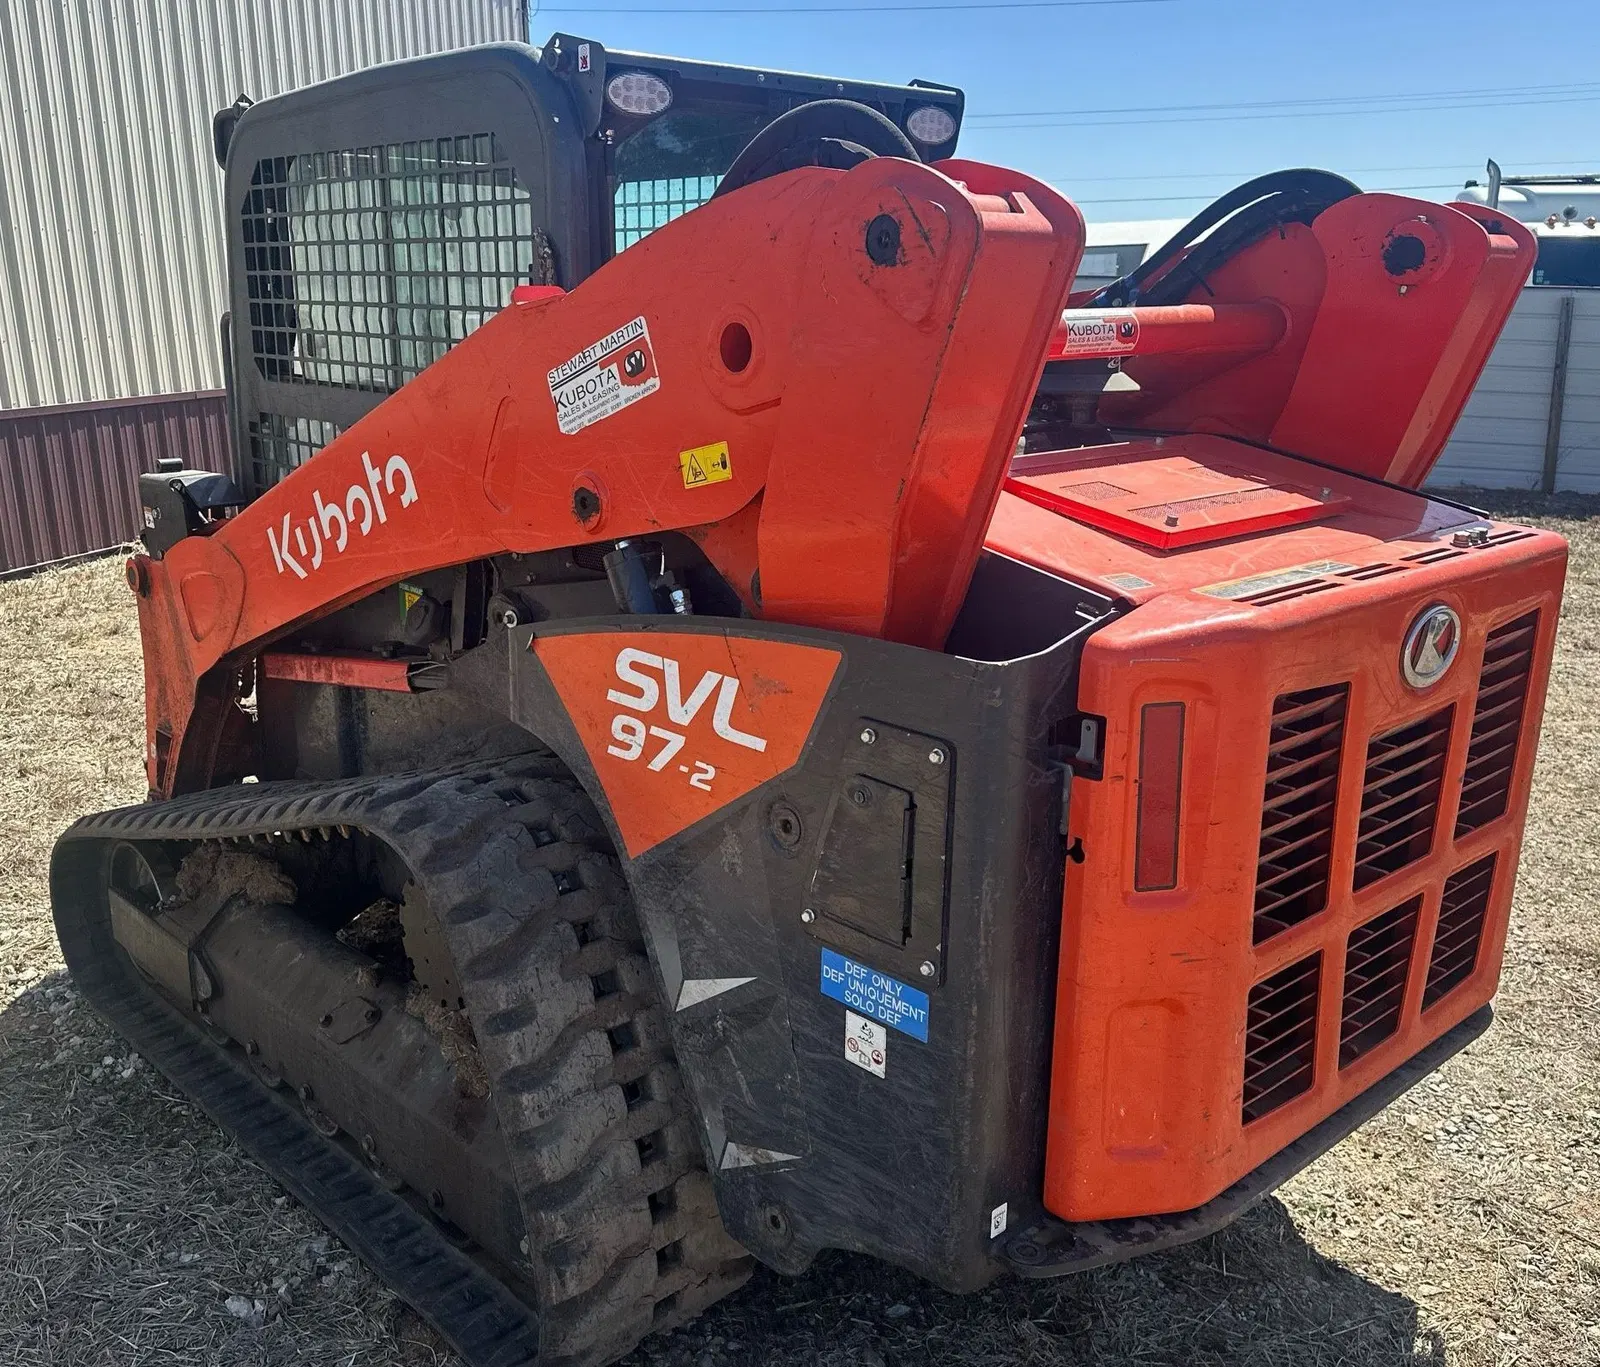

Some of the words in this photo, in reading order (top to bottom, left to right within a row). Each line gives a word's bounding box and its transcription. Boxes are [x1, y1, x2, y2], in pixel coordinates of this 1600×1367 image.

[548, 345, 597, 383] STEWART
[600, 318, 644, 353] MARTIN
[1067, 323, 1115, 336] KUBOTA
[553, 368, 617, 412] KUBOTA
[558, 405, 581, 421] SALES
[582, 401, 588, 409] &
[588, 382, 621, 405] LEASING
[267, 451, 419, 580] Kubota
[606, 647, 767, 752] SVL
[606, 714, 716, 791] 97-2
[823, 965, 845, 984] DEF
[848, 976, 926, 1023] UNIQUEMENT
[845, 960, 868, 979] DEF
[871, 974, 903, 997] ONLY
[844, 990, 874, 1013] SOLO
[878, 1006, 902, 1026] DEF
